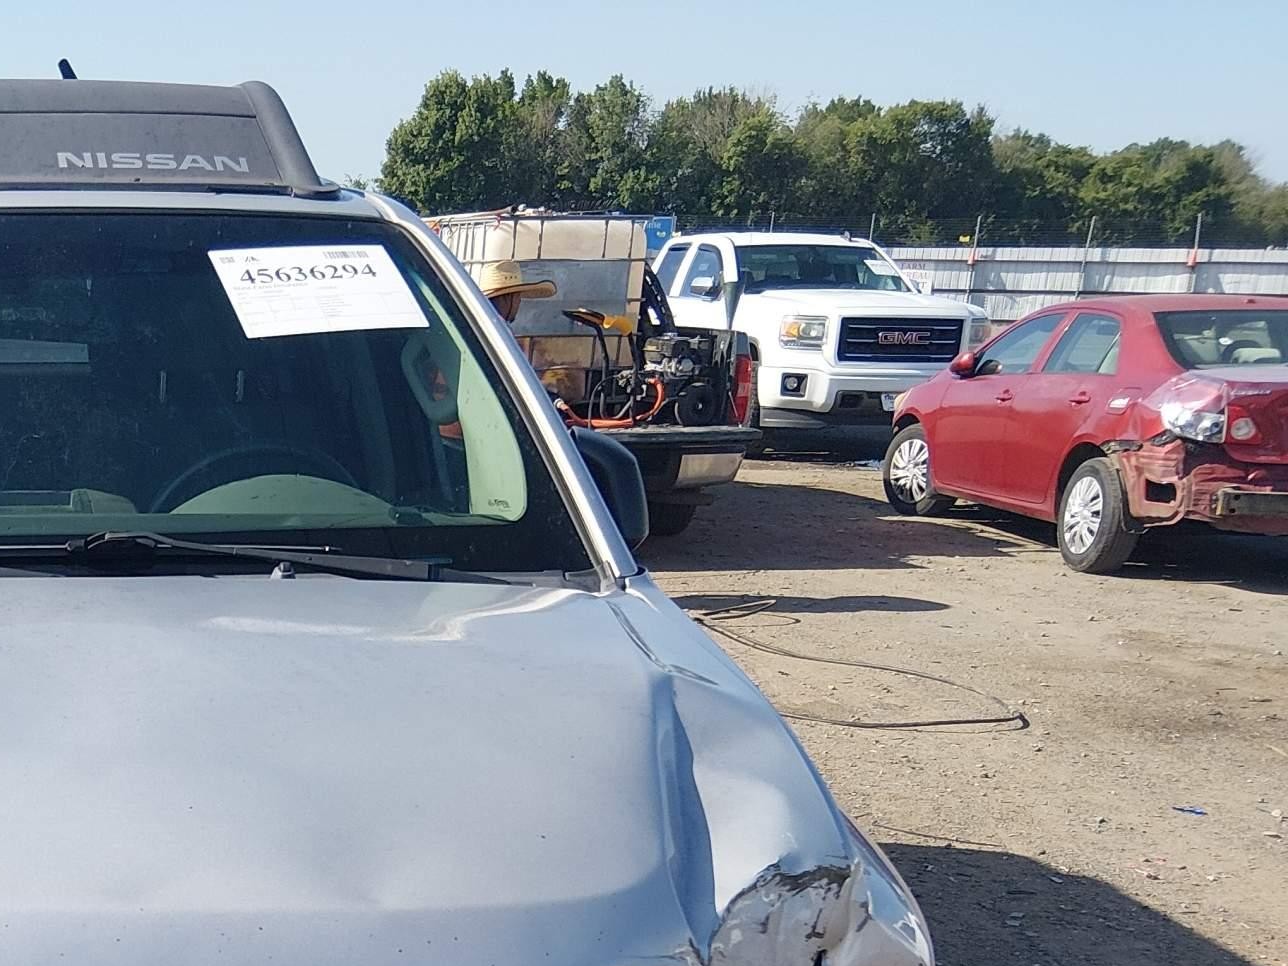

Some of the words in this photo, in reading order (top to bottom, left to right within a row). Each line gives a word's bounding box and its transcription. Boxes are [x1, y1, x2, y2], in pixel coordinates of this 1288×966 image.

[56, 152, 250, 172] NISSAN
[240, 263, 377, 284] 45636294
[878, 331, 931, 344] GMC
